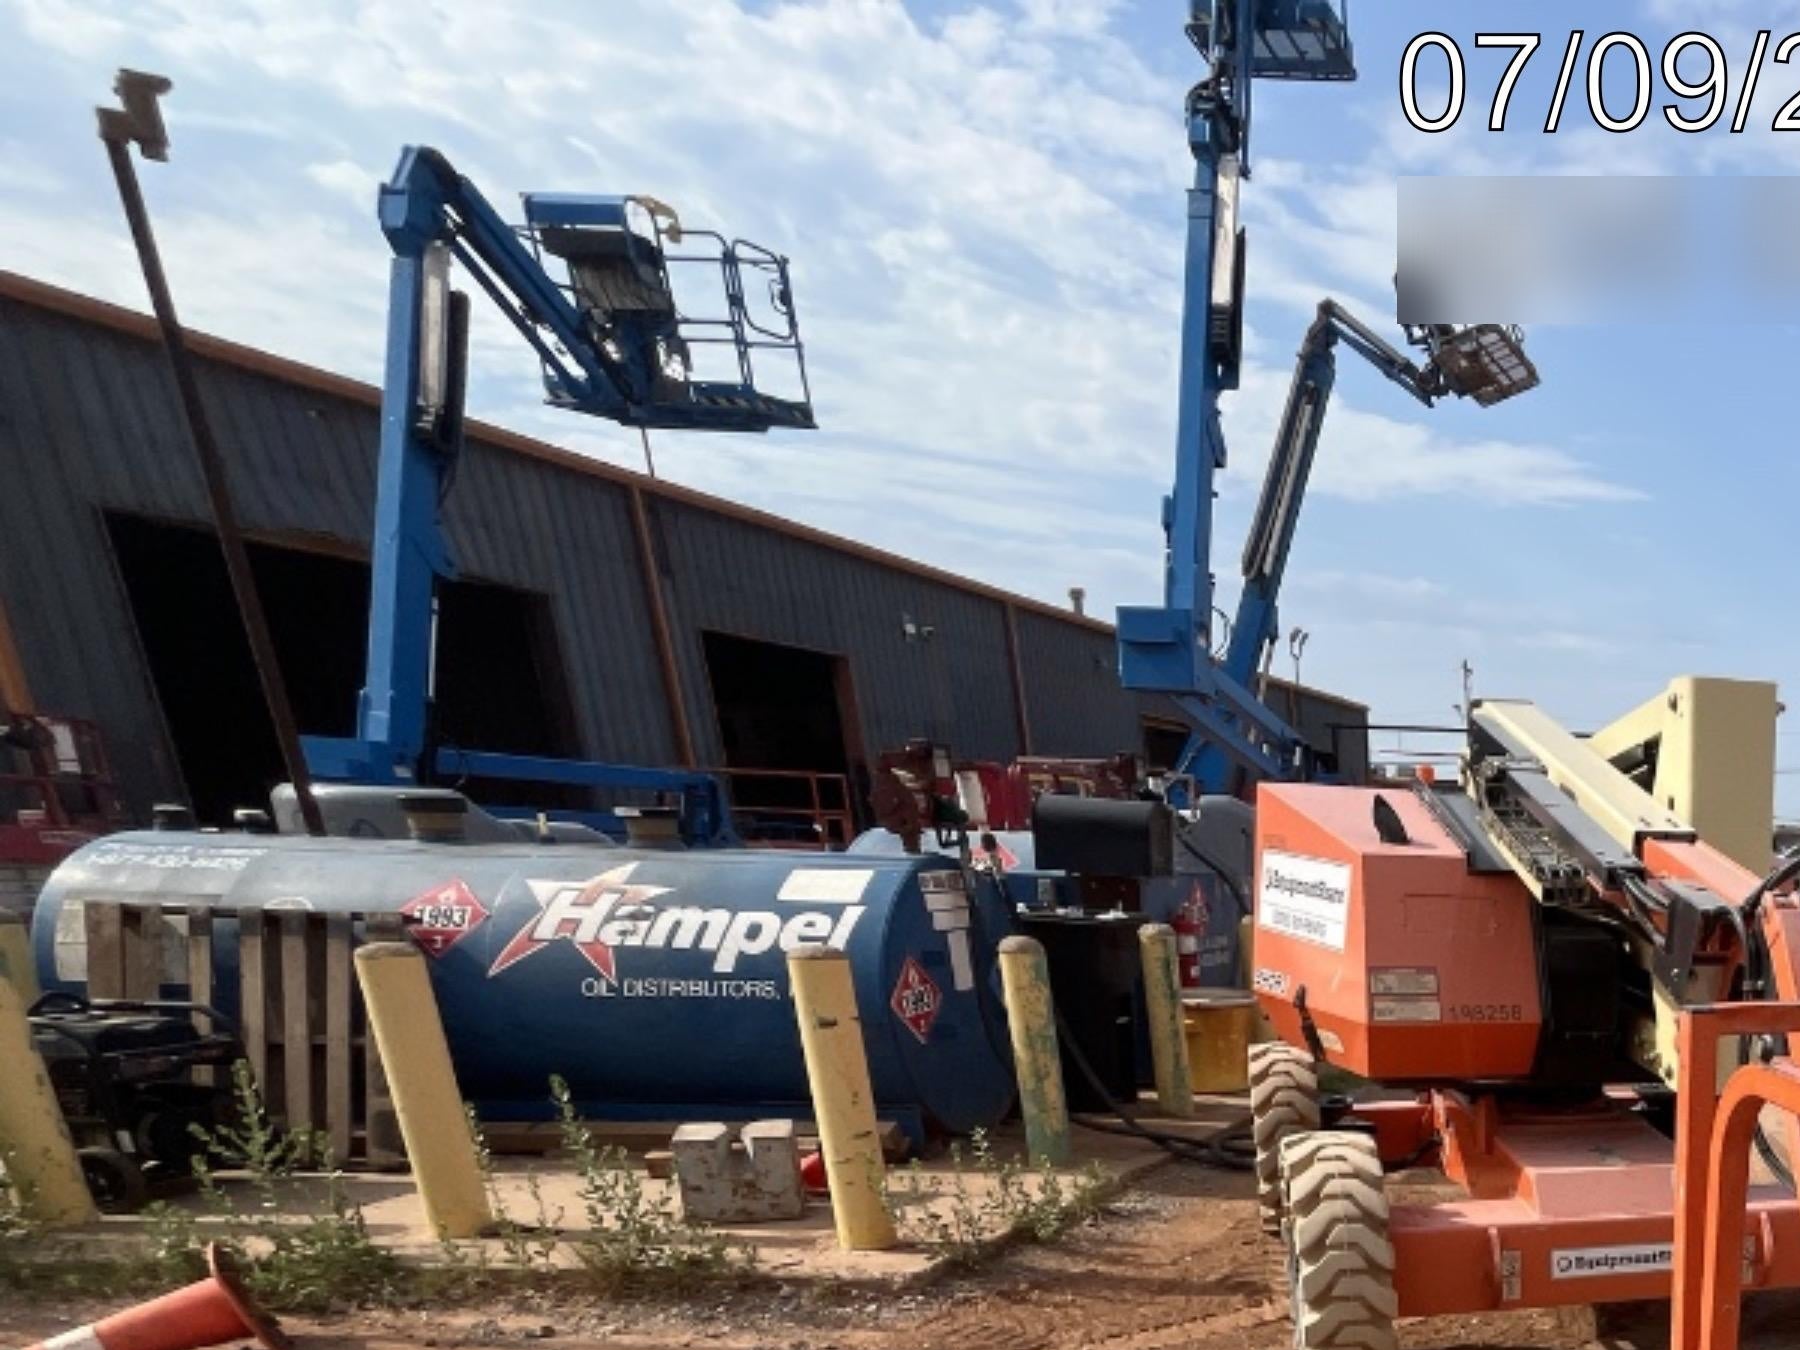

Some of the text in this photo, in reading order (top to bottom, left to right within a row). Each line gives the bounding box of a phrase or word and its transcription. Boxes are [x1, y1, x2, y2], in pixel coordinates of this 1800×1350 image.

[412, 906, 470, 929] 1993
[532, 888, 867, 974] Hampel
[580, 977, 617, 998] OIL
[622, 978, 782, 1000] DISTRIBUTORS,
